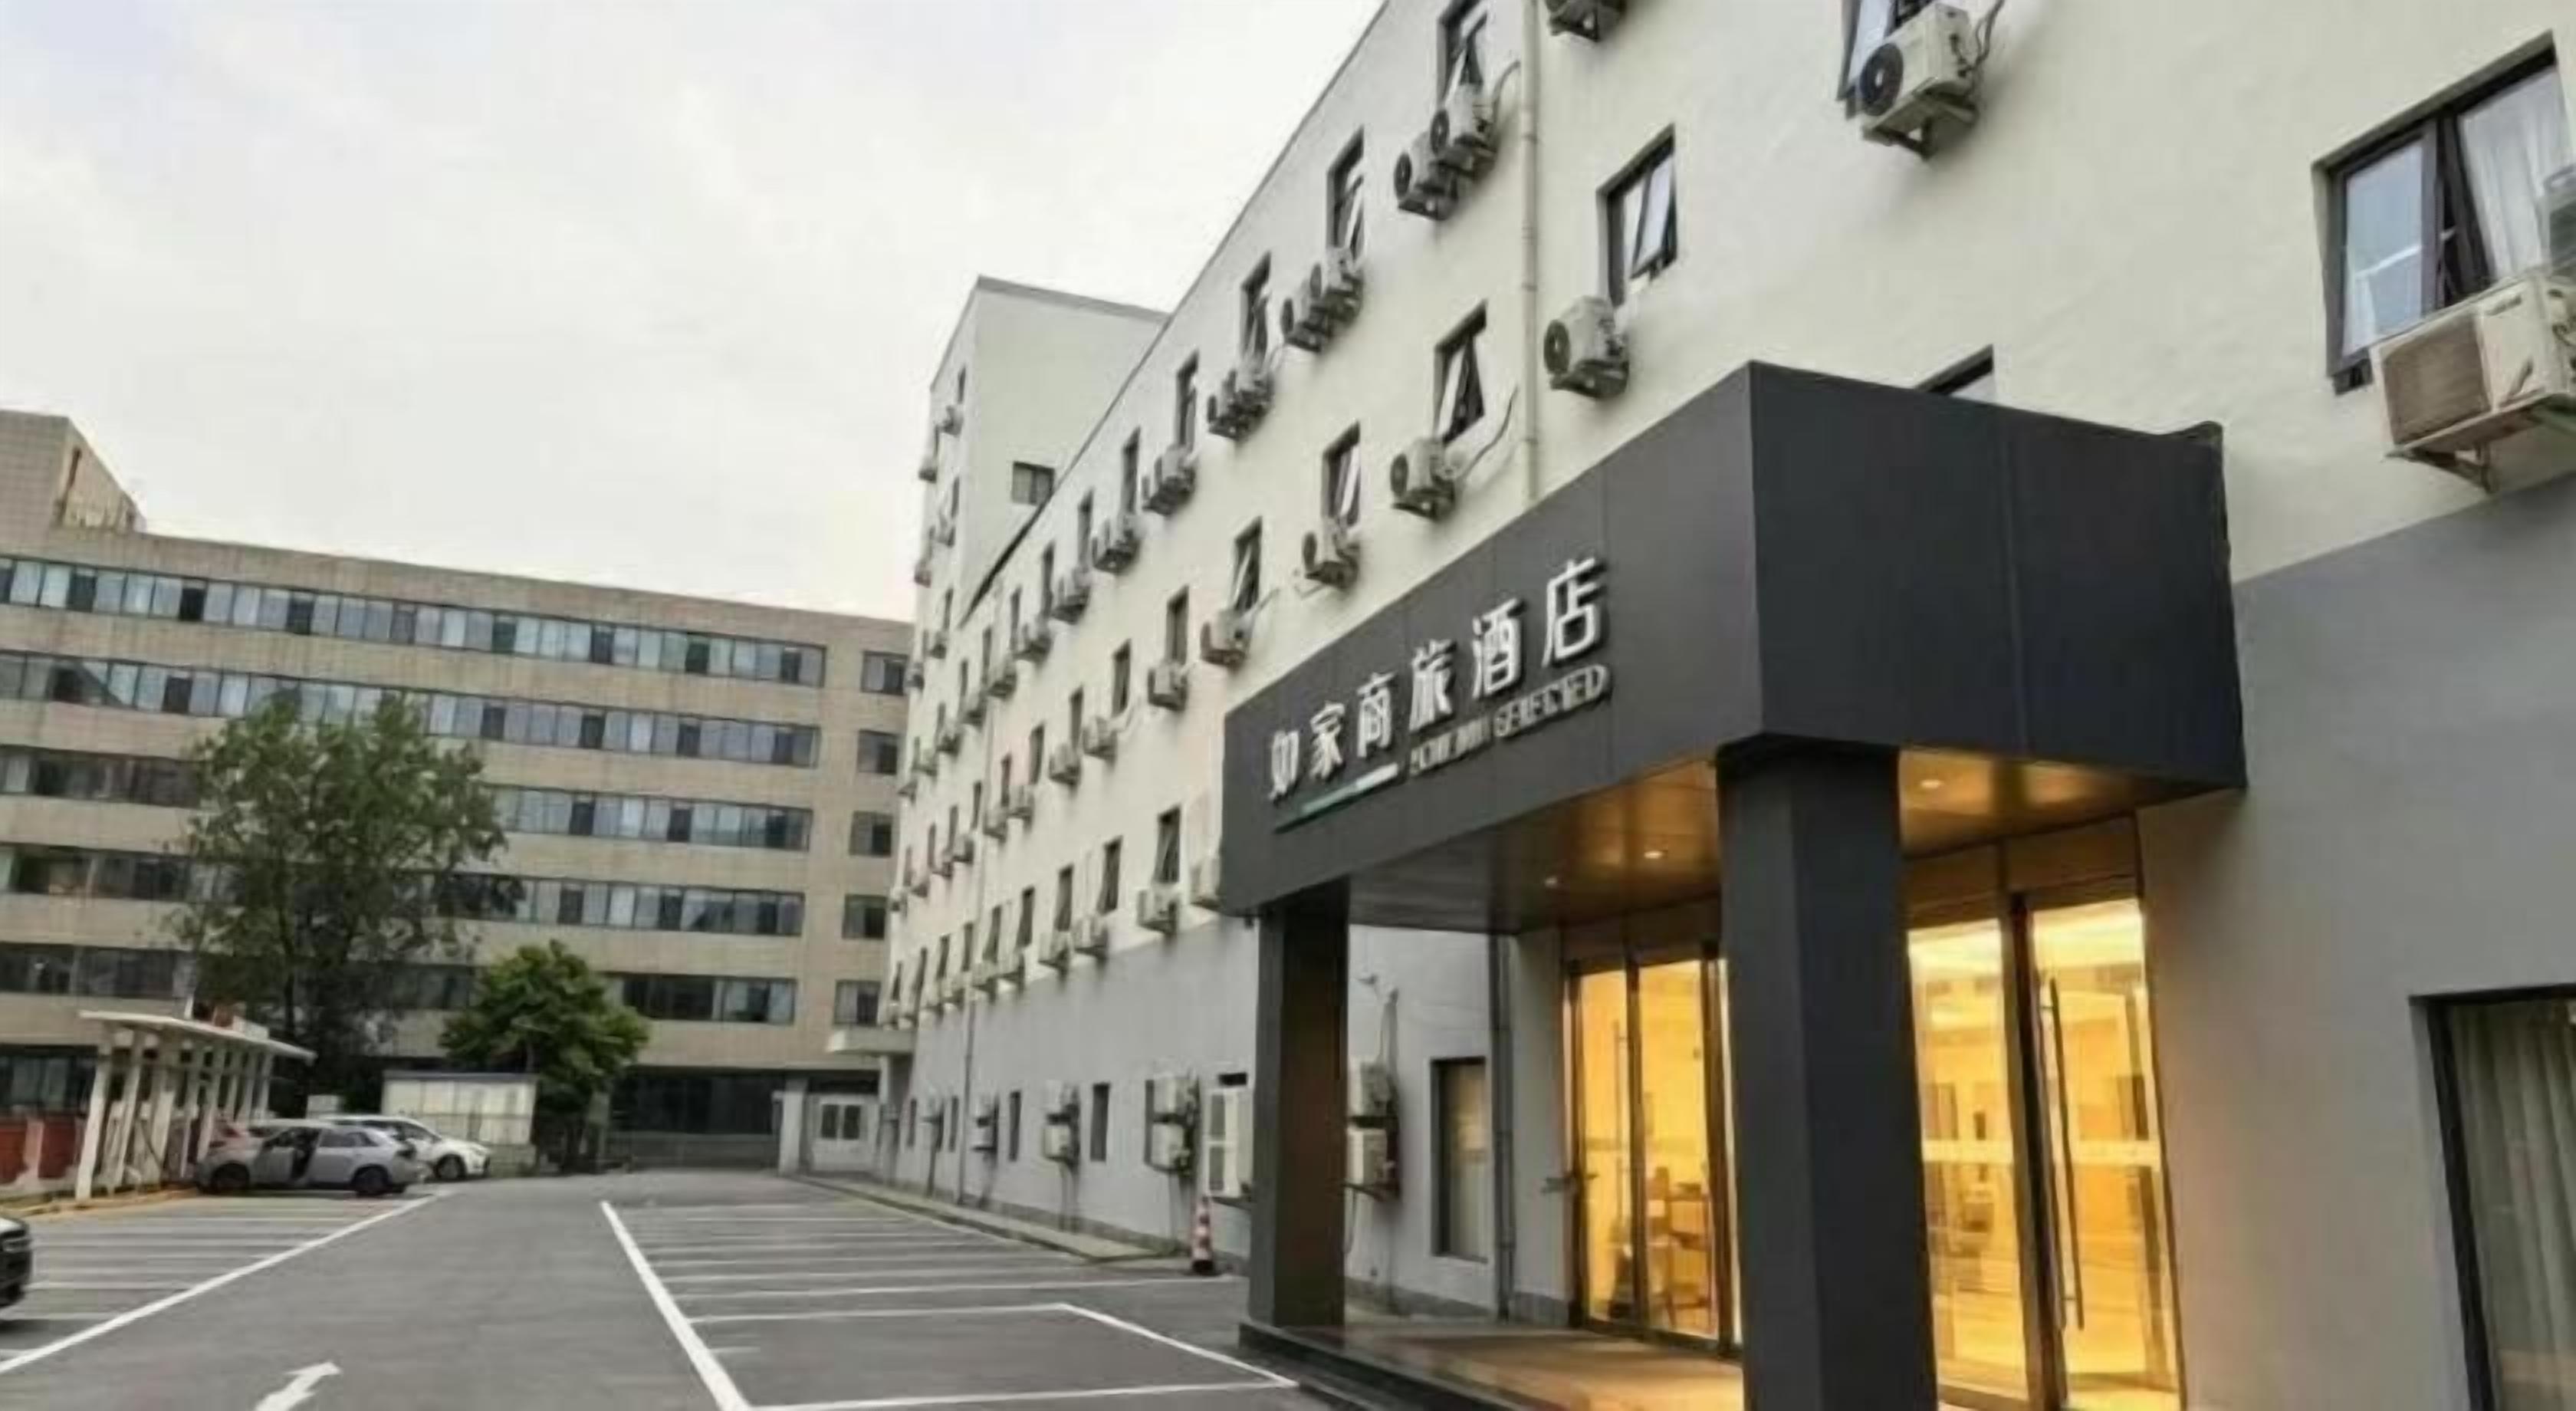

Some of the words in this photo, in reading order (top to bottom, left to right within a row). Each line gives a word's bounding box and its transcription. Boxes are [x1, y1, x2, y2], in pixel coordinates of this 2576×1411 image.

[1269, 557, 1600, 799] 如家商旅酒店
